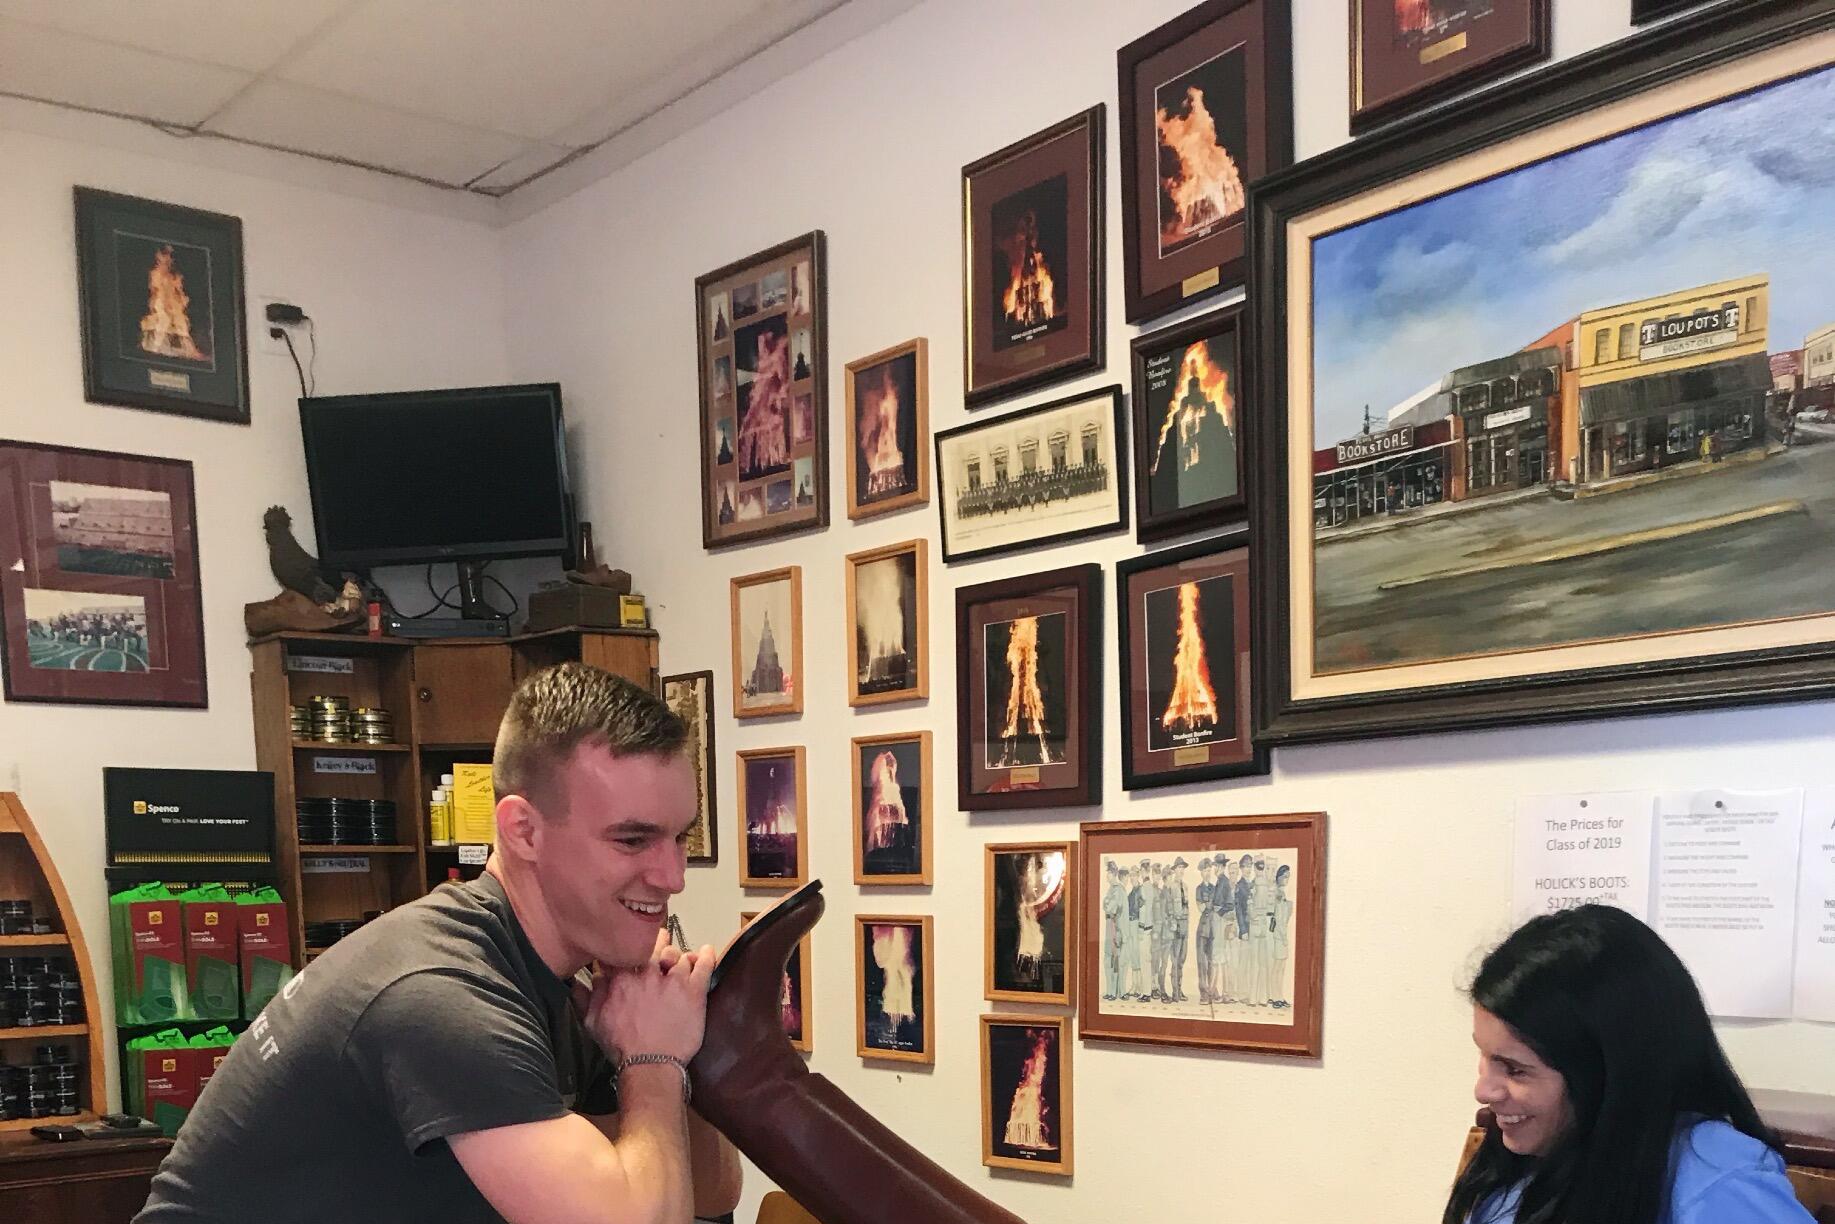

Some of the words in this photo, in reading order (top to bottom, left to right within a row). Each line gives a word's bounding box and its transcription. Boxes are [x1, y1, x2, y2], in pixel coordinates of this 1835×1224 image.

[1339, 428, 1409, 461] BOOKSTORE
[147, 803, 180, 814] Spenco
[1545, 820, 1567, 831] The
[1570, 819, 1604, 830] Prices
[1607, 817, 1624, 829] for
[1546, 839, 1575, 851] Class
[1578, 837, 1591, 850] of
[1593, 837, 1622, 850] 2019
[1535, 877, 1586, 890] HOLICK'S
[1547, 896, 1600, 909] $172500
